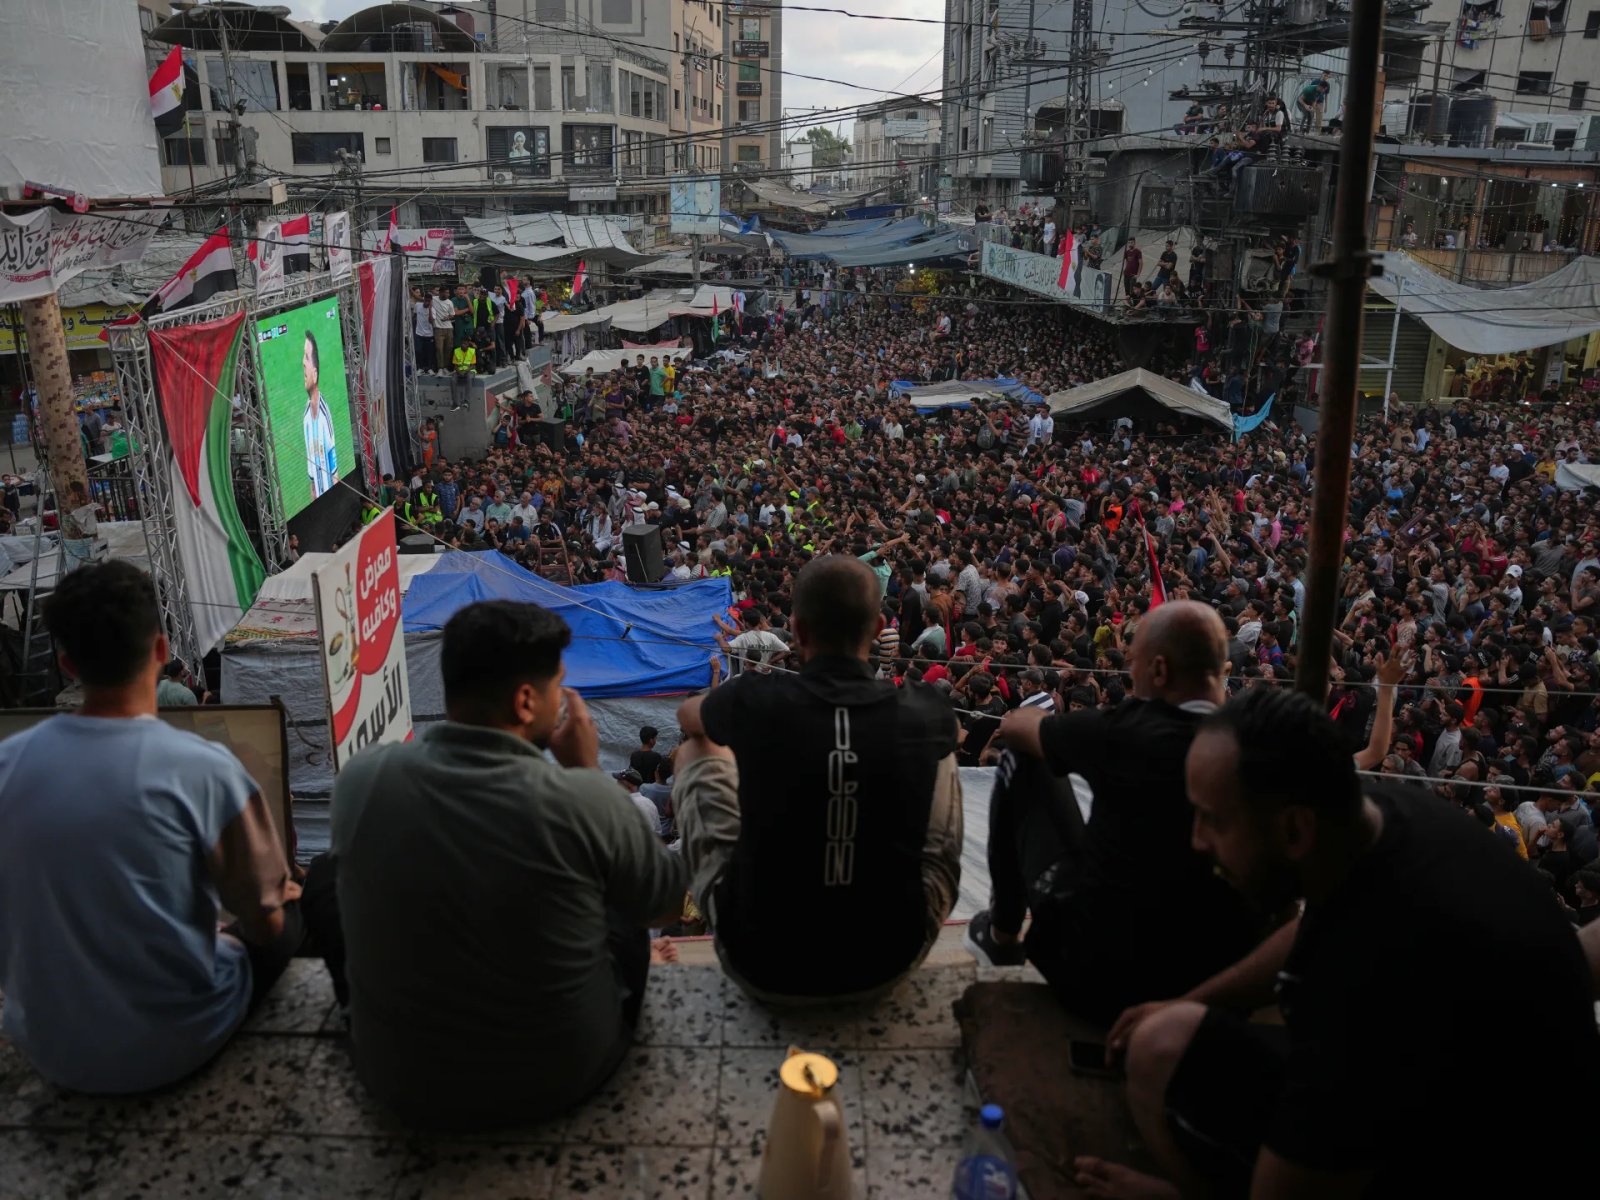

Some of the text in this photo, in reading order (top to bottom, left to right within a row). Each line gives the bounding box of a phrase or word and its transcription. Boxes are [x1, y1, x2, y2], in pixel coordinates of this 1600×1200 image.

[360, 546, 391, 600] معرض
[362, 587, 396, 643] وكافيه
[824, 706, 859, 886] ICON
